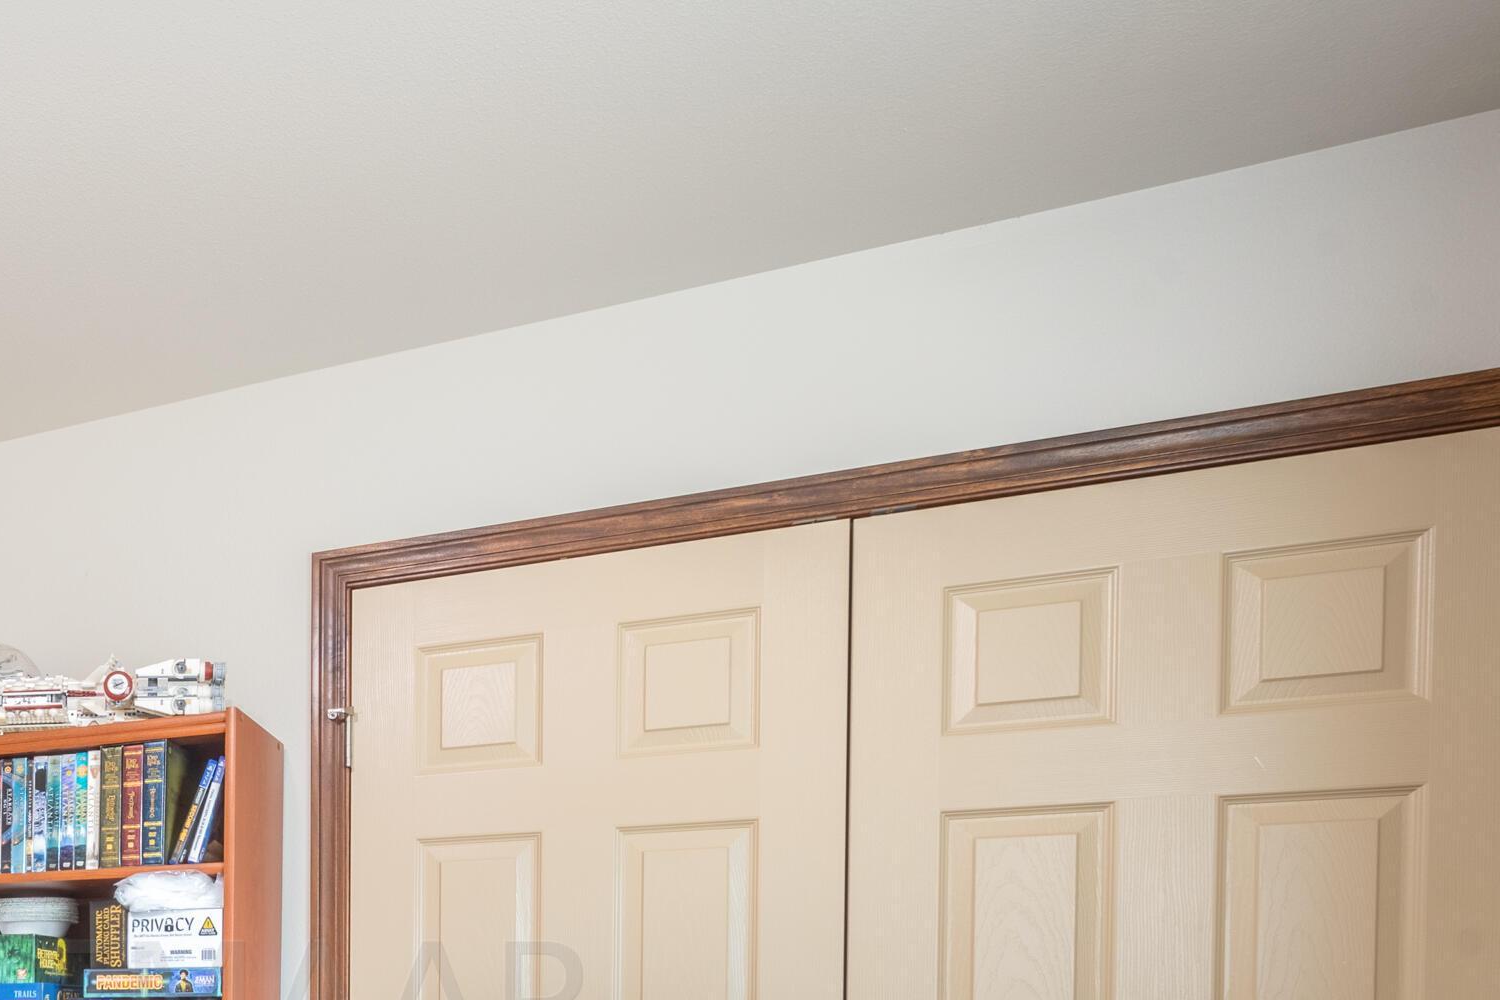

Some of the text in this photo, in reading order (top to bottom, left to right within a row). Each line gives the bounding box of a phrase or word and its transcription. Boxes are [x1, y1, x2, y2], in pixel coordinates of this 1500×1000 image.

[132, 917, 194, 933] PRIVACY
[110, 904, 122, 968] SHUFFLER
[96, 974, 164, 990] PANDEMIC
[14, 990, 36, 998] TRAILS
